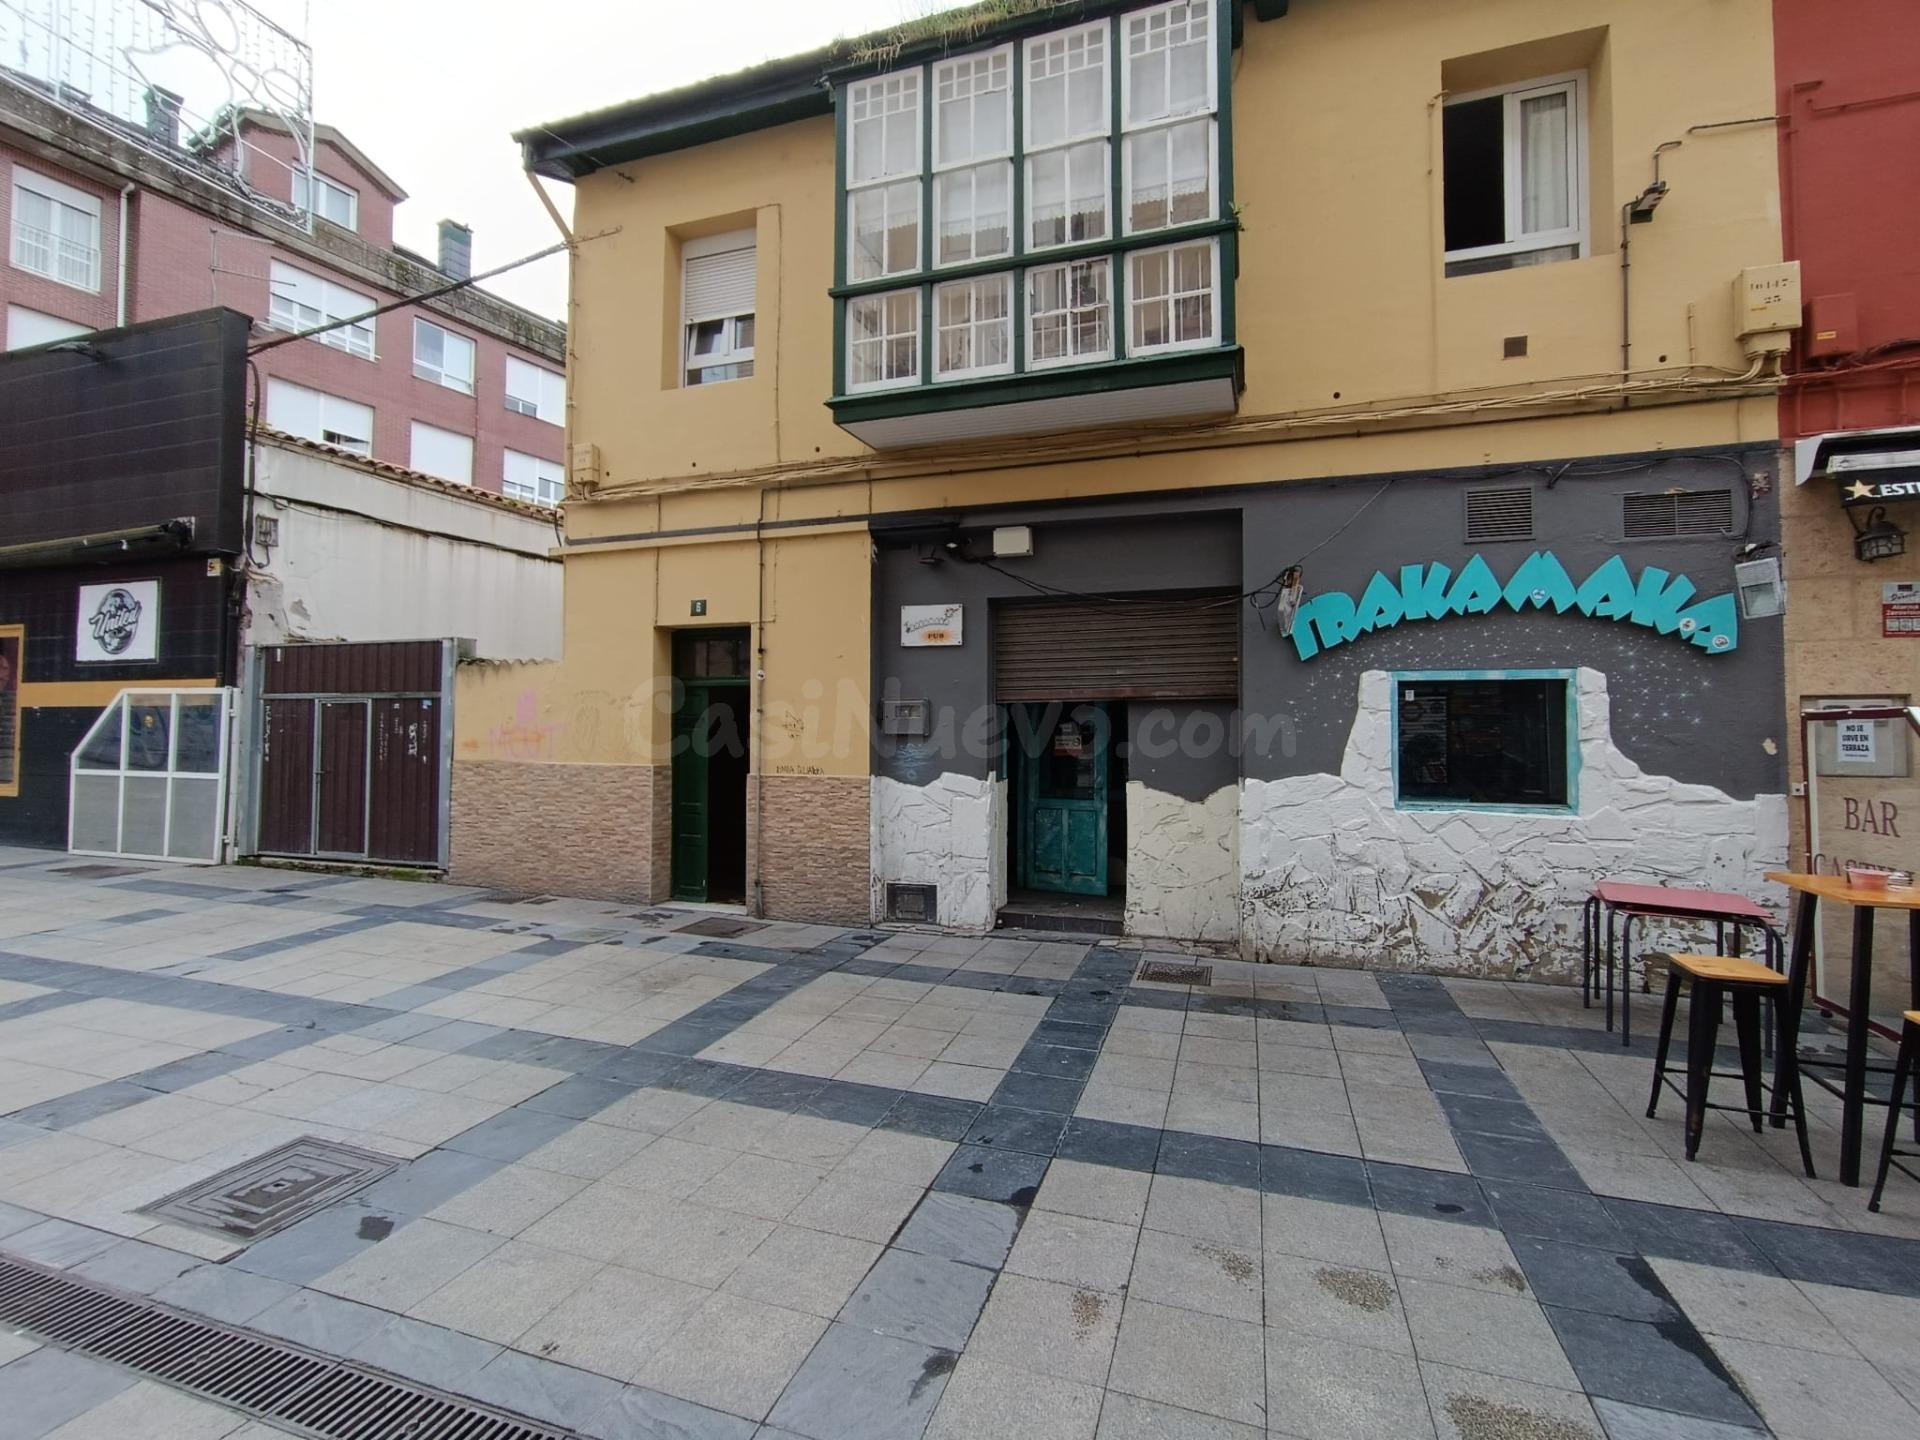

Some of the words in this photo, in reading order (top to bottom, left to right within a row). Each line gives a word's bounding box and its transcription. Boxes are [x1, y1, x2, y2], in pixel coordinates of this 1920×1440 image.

[1880, 482, 1920, 496] EST
[927, 632, 945, 640] PUB
[1843, 796, 1901, 838] BAR
